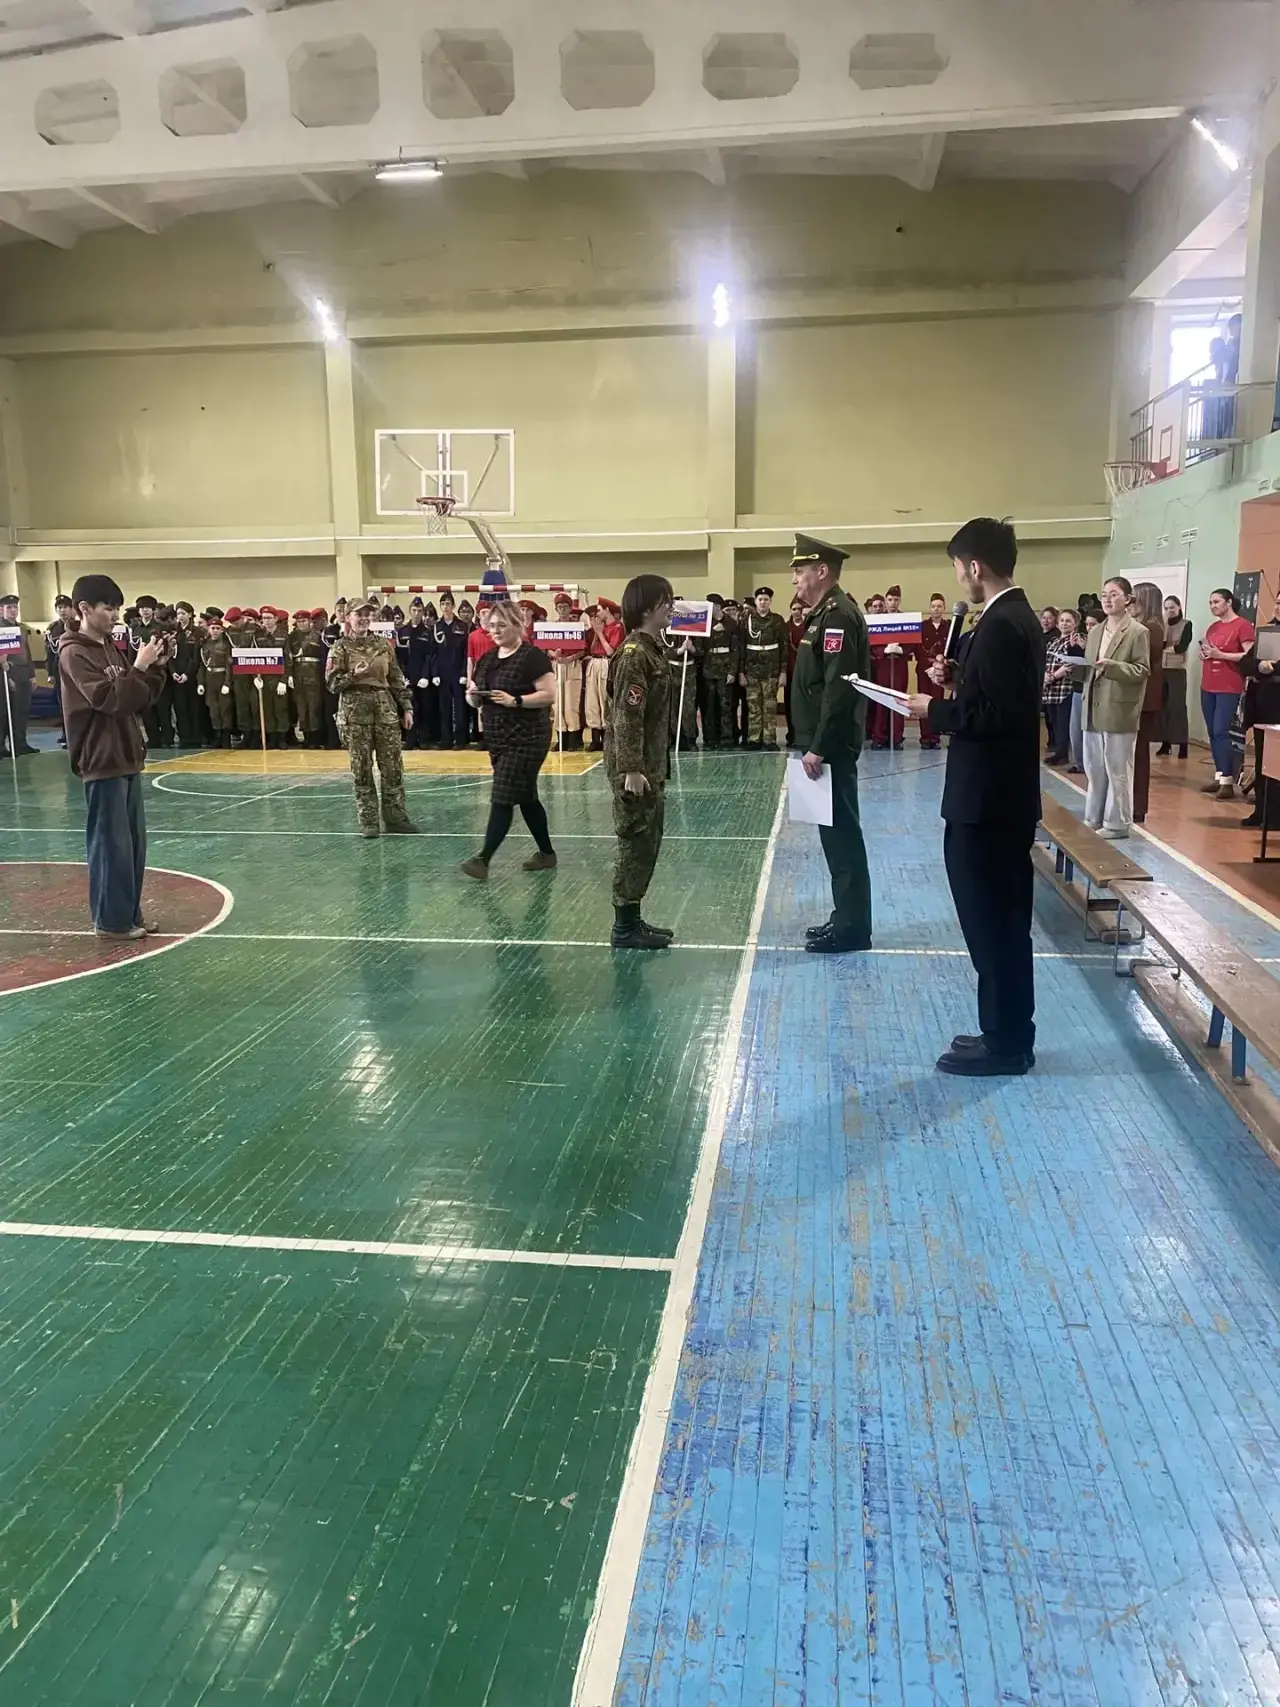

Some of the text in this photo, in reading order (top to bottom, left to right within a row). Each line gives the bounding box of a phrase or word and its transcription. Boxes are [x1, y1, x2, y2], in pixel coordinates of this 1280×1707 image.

[537, 631, 582, 640] Школа №46
[237, 656, 279, 666] Школа №7
